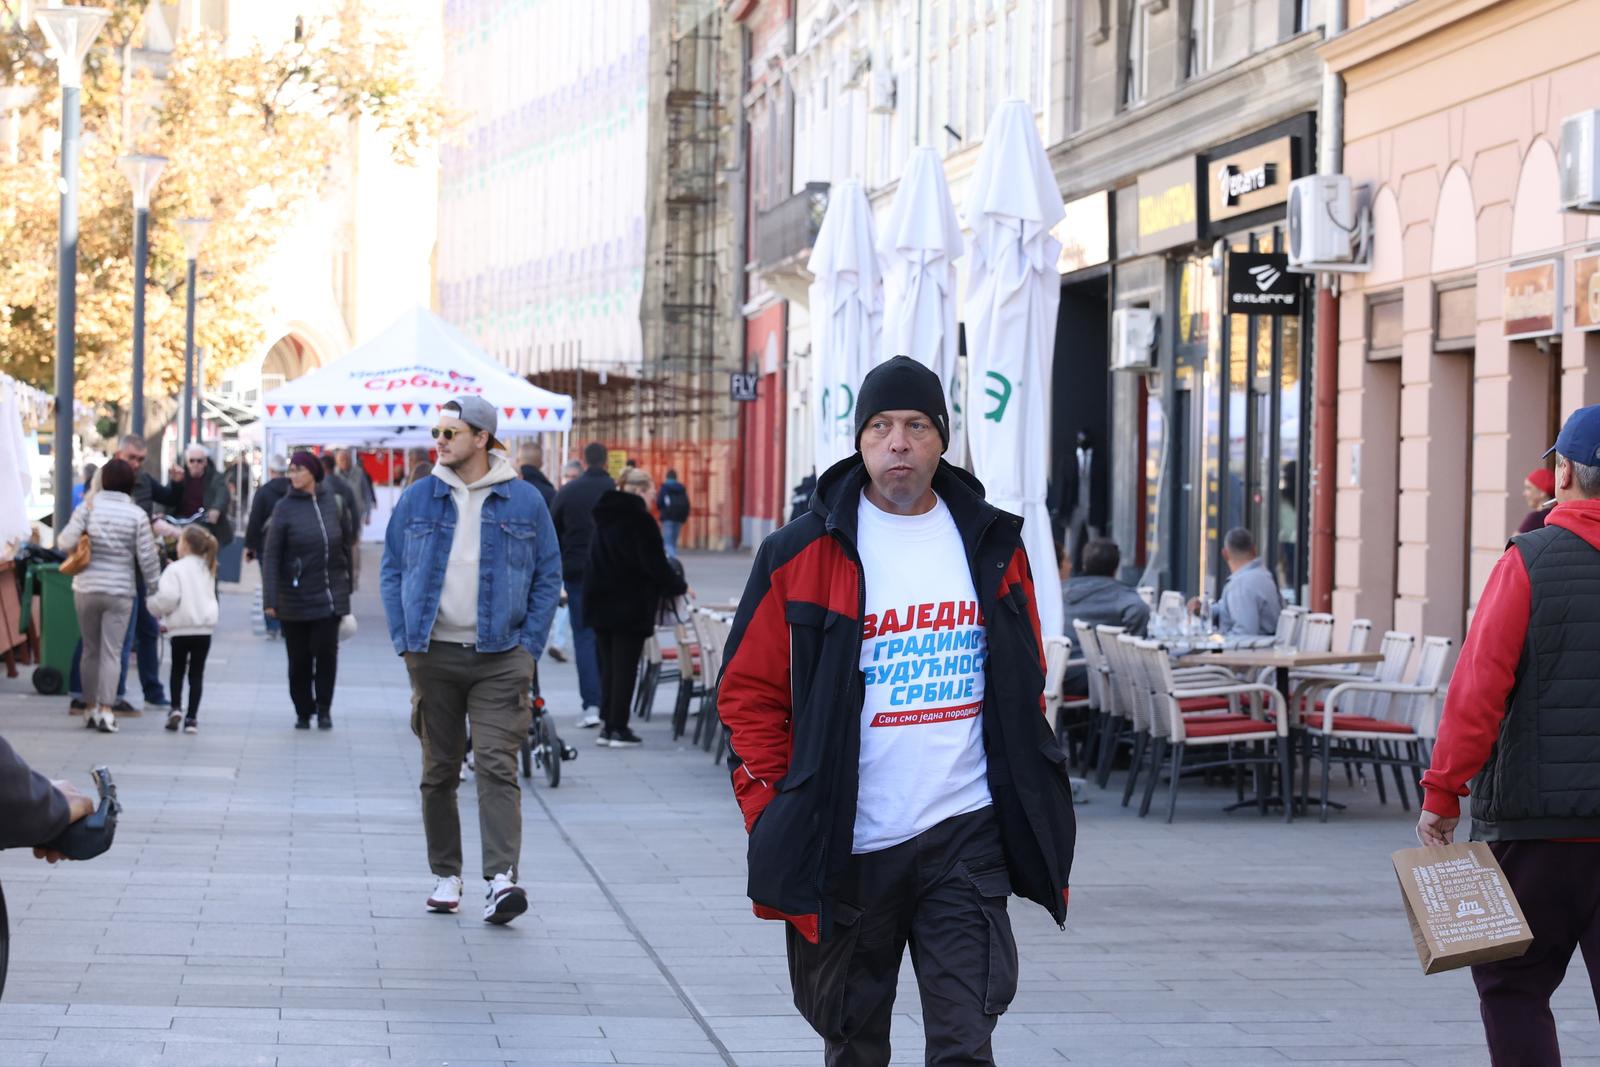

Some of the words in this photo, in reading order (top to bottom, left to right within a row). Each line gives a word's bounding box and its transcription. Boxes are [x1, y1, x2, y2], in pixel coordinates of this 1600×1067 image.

[364, 374, 483, 393] Србија
[732, 374, 757, 395] FLY
[873, 630, 982, 661] ГРАДИМО
[890, 678, 975, 706] СРБИЈЕ
[878, 714, 898, 724] Сви
[899, 714, 918, 723] смо
[919, 711, 943, 723] једна
[1457, 900, 1479, 913] dm
